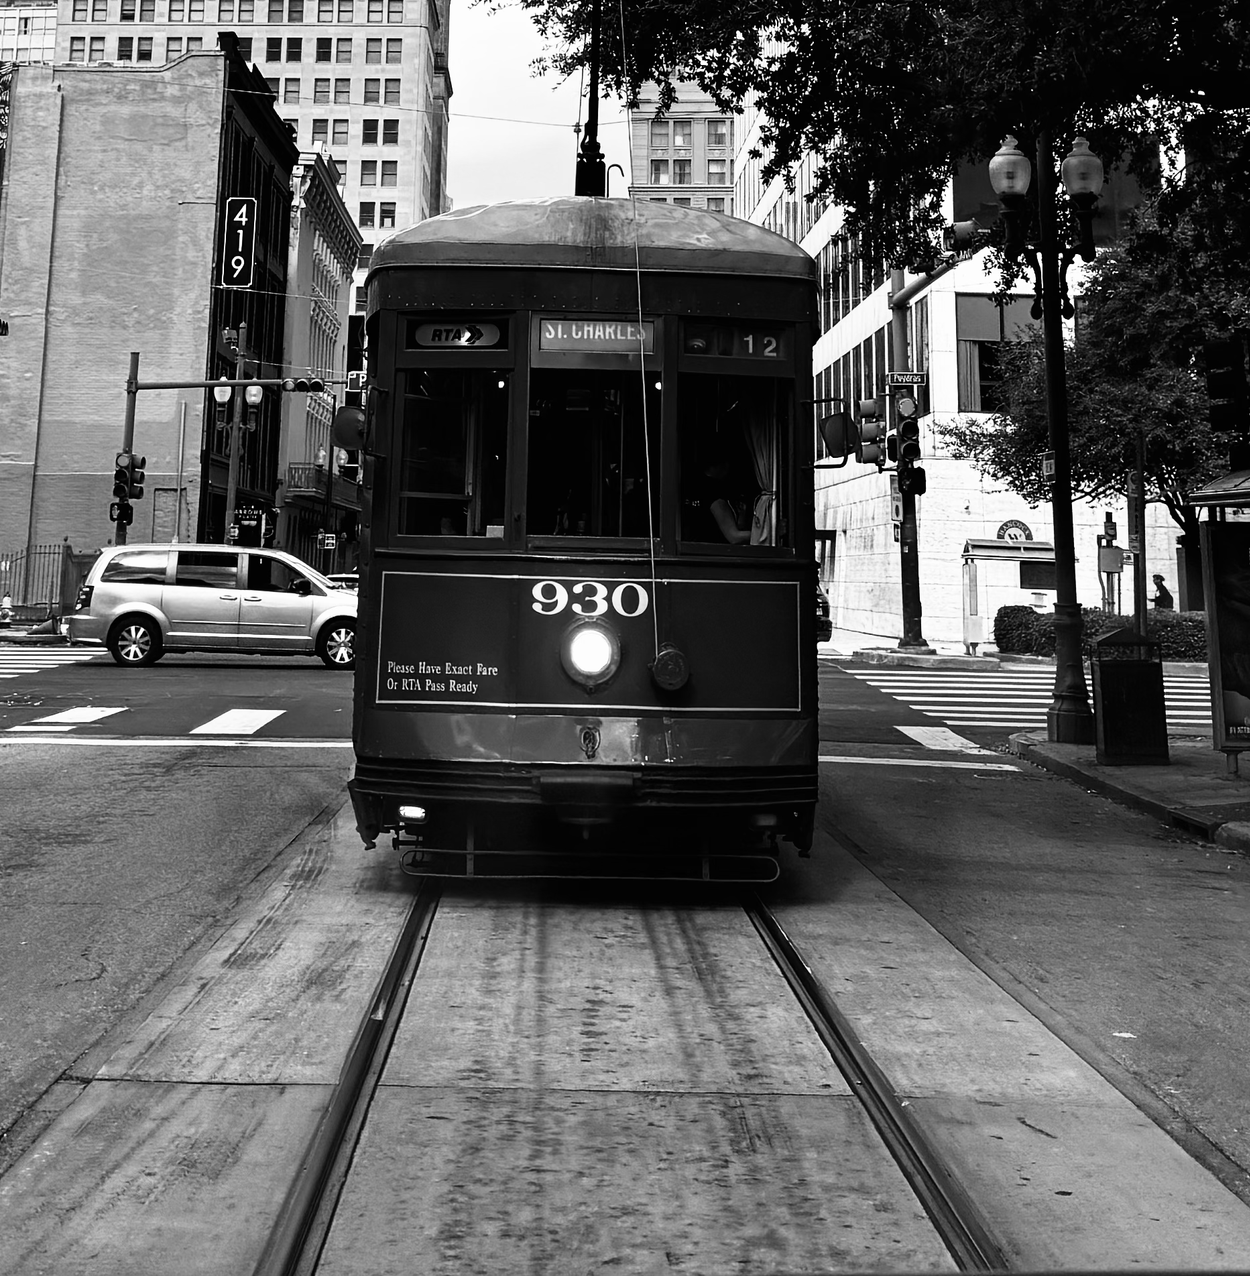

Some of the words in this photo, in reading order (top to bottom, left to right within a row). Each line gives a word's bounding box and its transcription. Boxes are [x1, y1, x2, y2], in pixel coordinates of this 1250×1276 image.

[231, 203, 249, 278] 419
[431, 328, 462, 342] RTA
[531, 580, 649, 617] 930
[387, 660, 415, 674] Please
[418, 661, 442, 675] Have
[445, 662, 473, 675] Exact
[476, 663, 499, 676] Fare
[386, 677, 399, 690] Or
[401, 678, 422, 691] RTA
[425, 679, 446, 692] Pass
[449, 679, 479, 695] Ready
